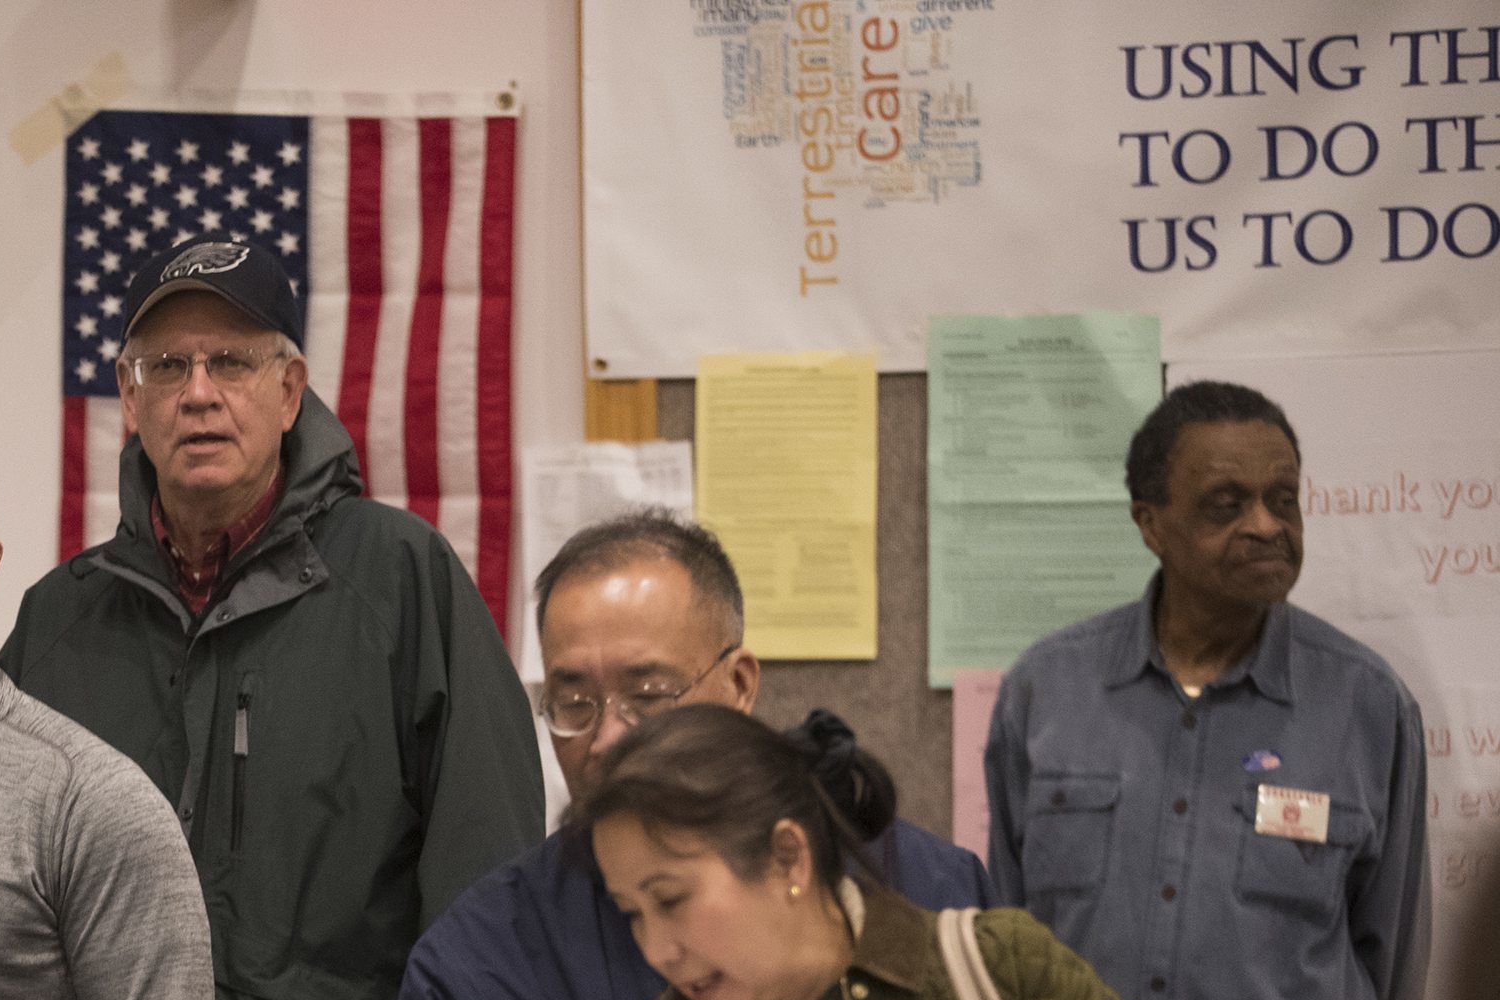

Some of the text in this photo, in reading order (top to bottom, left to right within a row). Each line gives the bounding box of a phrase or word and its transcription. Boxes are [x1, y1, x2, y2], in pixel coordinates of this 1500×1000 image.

[857, 16, 901, 162] Care
[1118, 34, 1367, 101] USING
[1118, 129, 1232, 188] TO
[1256, 121, 1380, 182] DO
[1120, 203, 1500, 273] US TO DO
